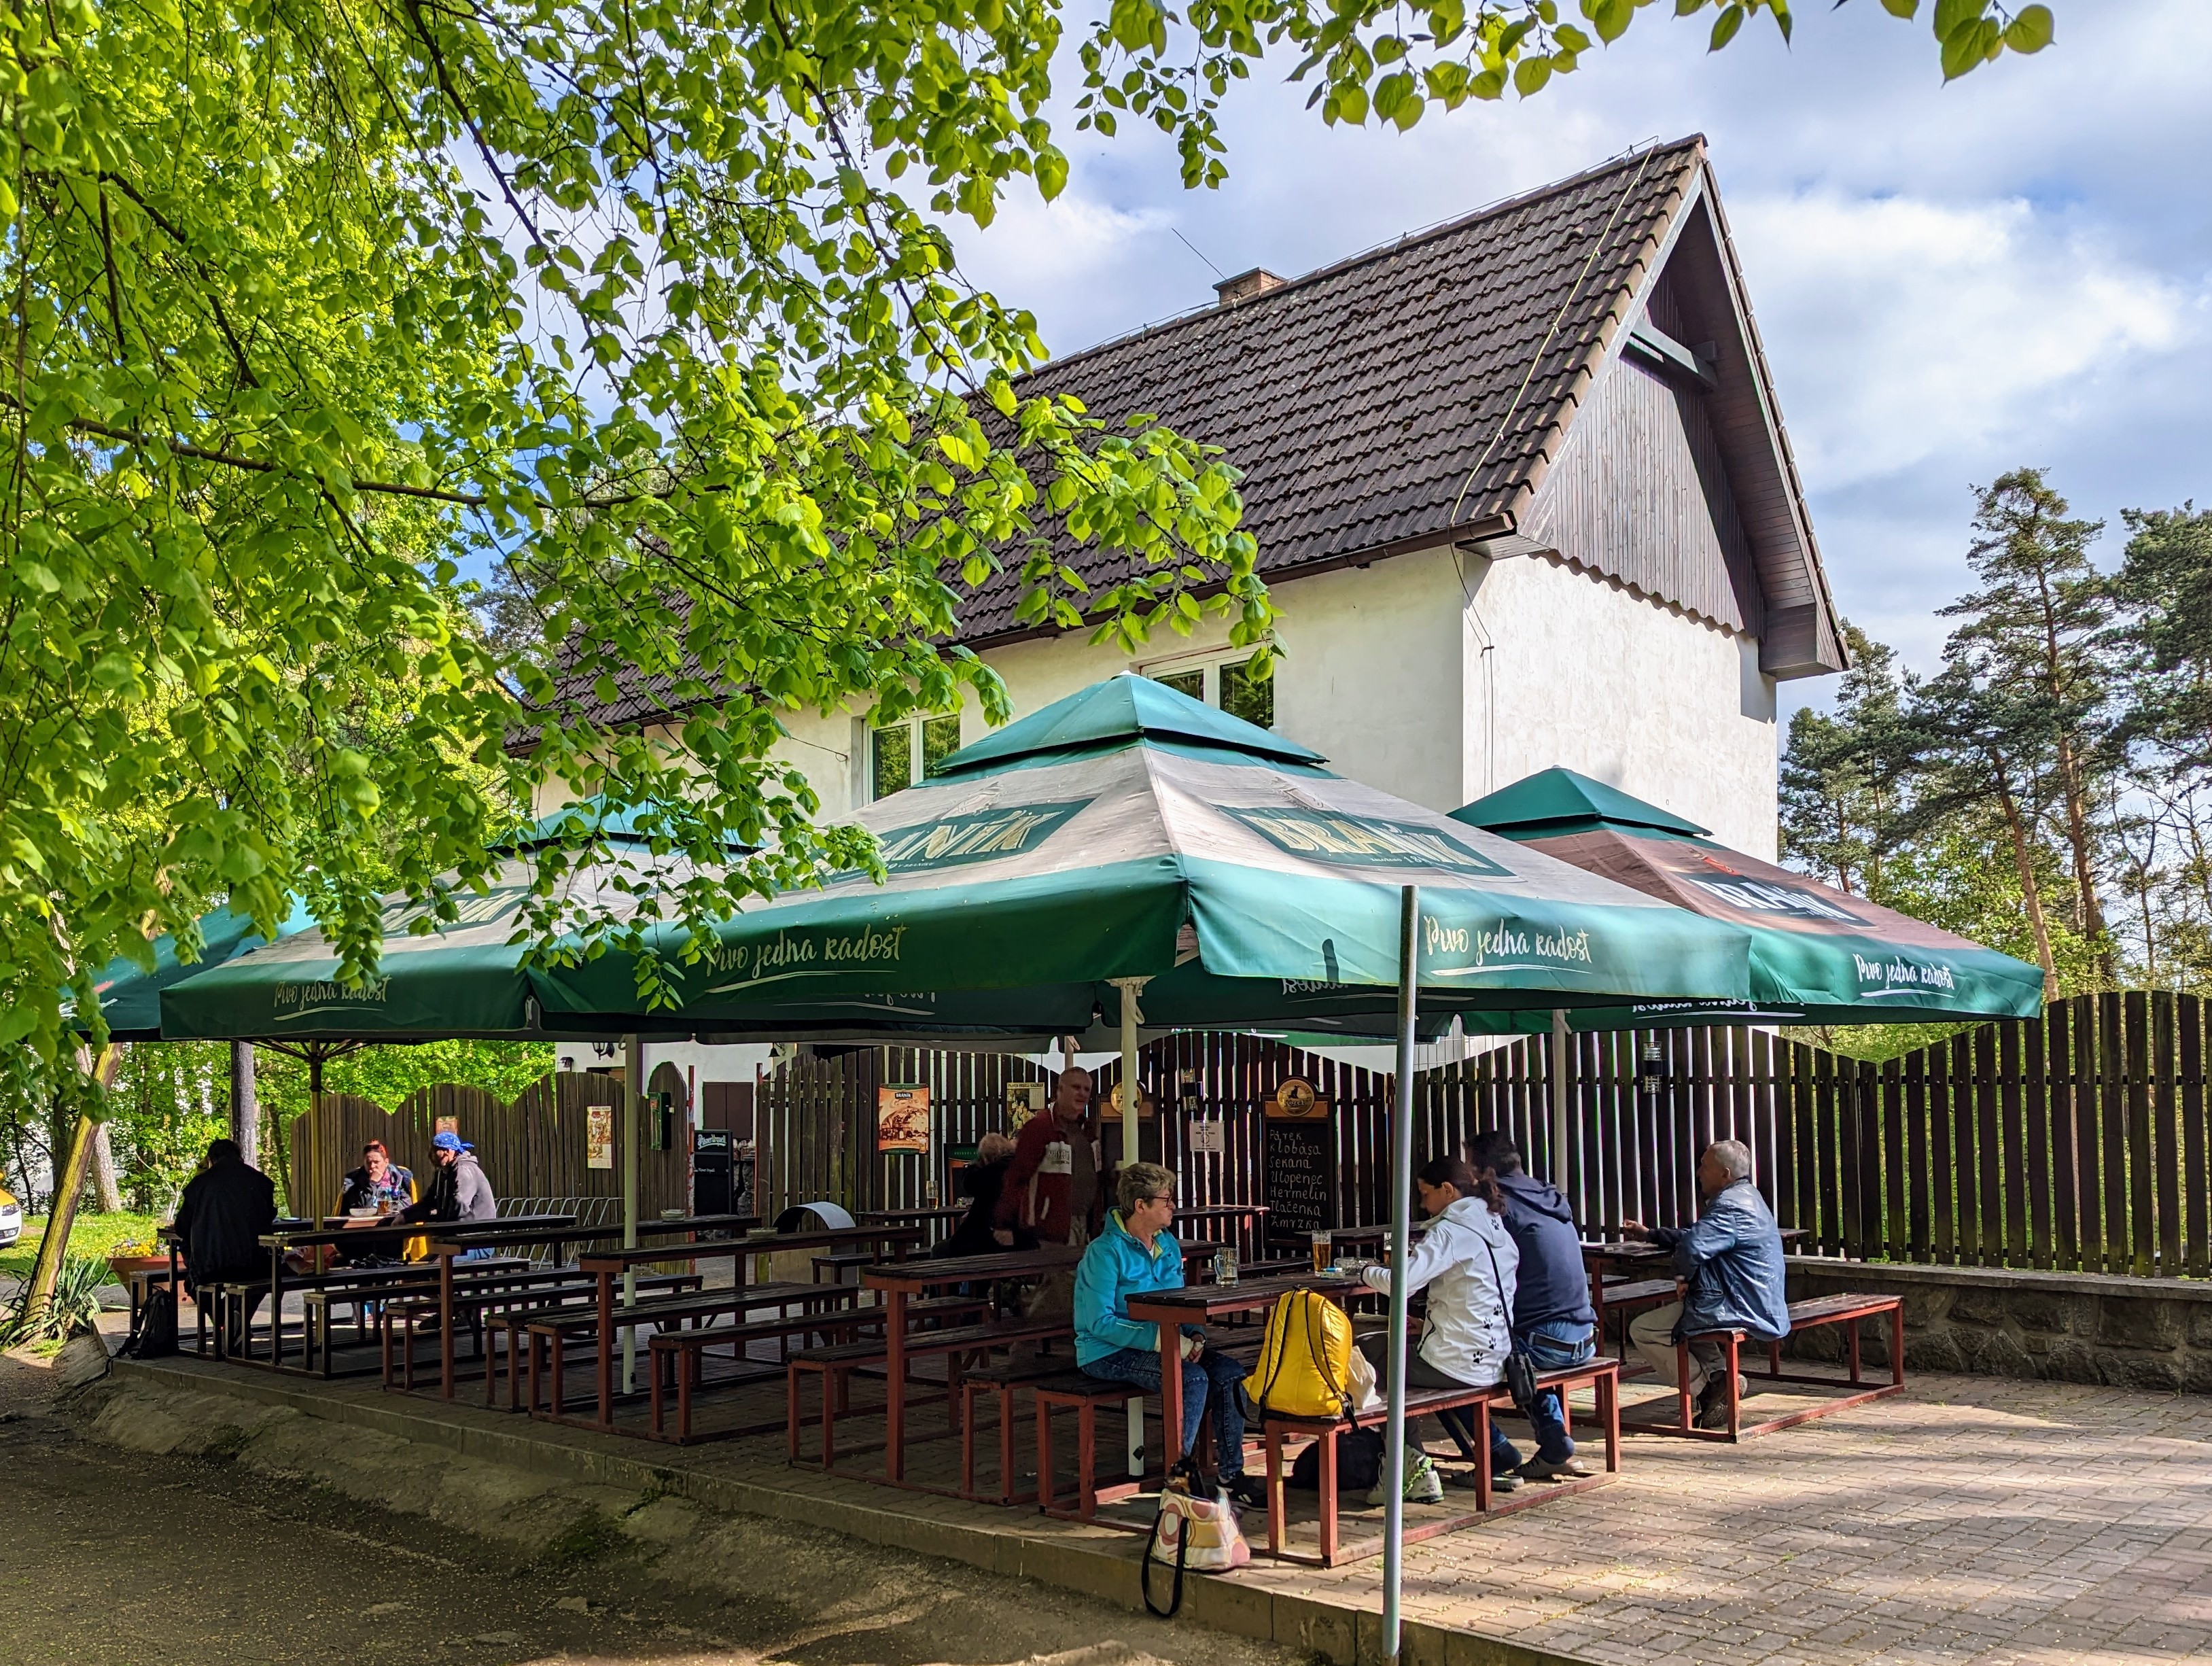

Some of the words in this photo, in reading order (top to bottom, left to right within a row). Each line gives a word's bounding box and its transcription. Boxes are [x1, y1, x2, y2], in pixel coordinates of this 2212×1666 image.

[752, 929, 817, 979] jedna
[1476, 918, 1530, 966] jedna
[1886, 956, 1918, 989] jedna
[1268, 1156, 1312, 1168] Sekaná
[1270, 1170, 1322, 1190] Utopenec
